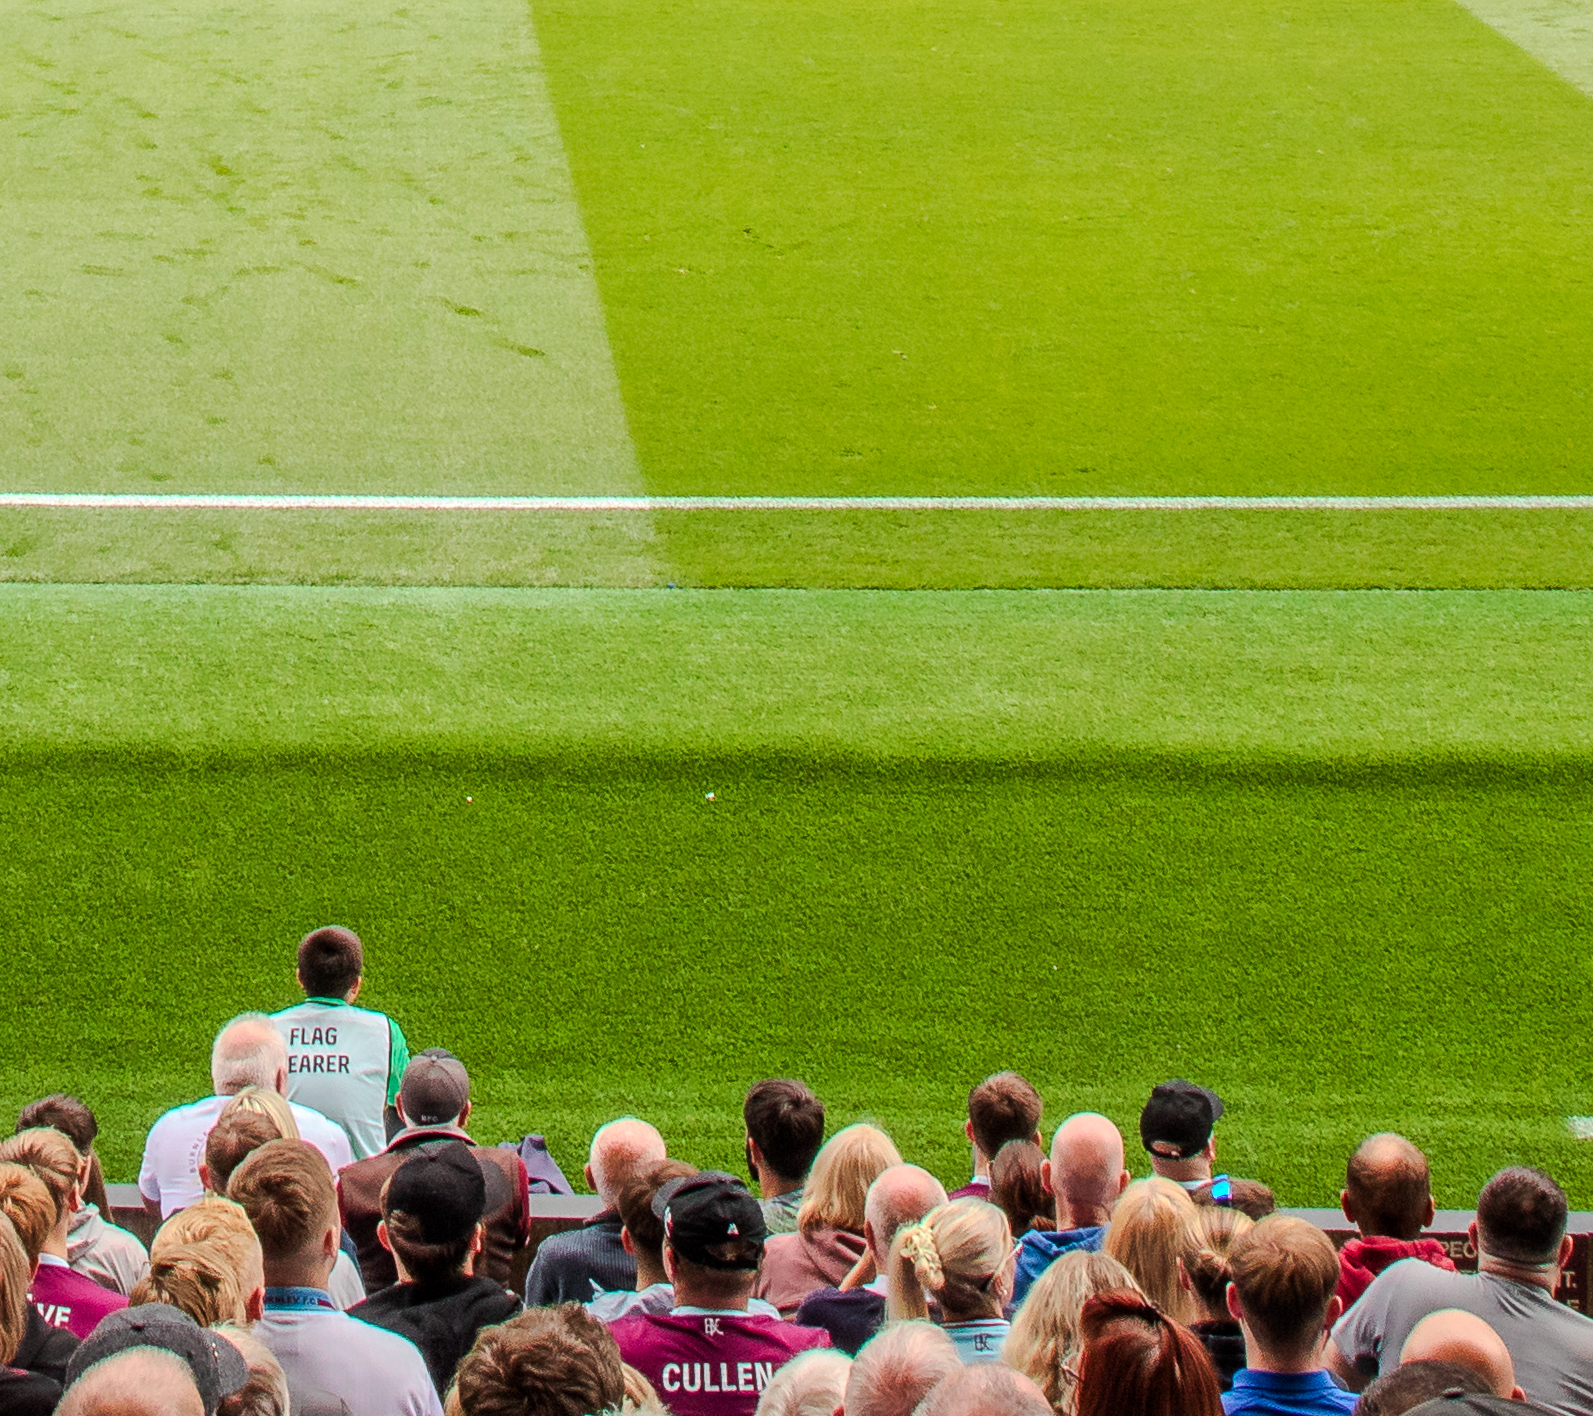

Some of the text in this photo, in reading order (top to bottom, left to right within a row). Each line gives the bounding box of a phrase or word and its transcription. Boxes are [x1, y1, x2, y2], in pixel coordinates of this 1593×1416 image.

[290, 1027, 337, 1046] FLAG
[288, 1054, 351, 1074] EARER
[662, 1362, 774, 1393] CULLEN
